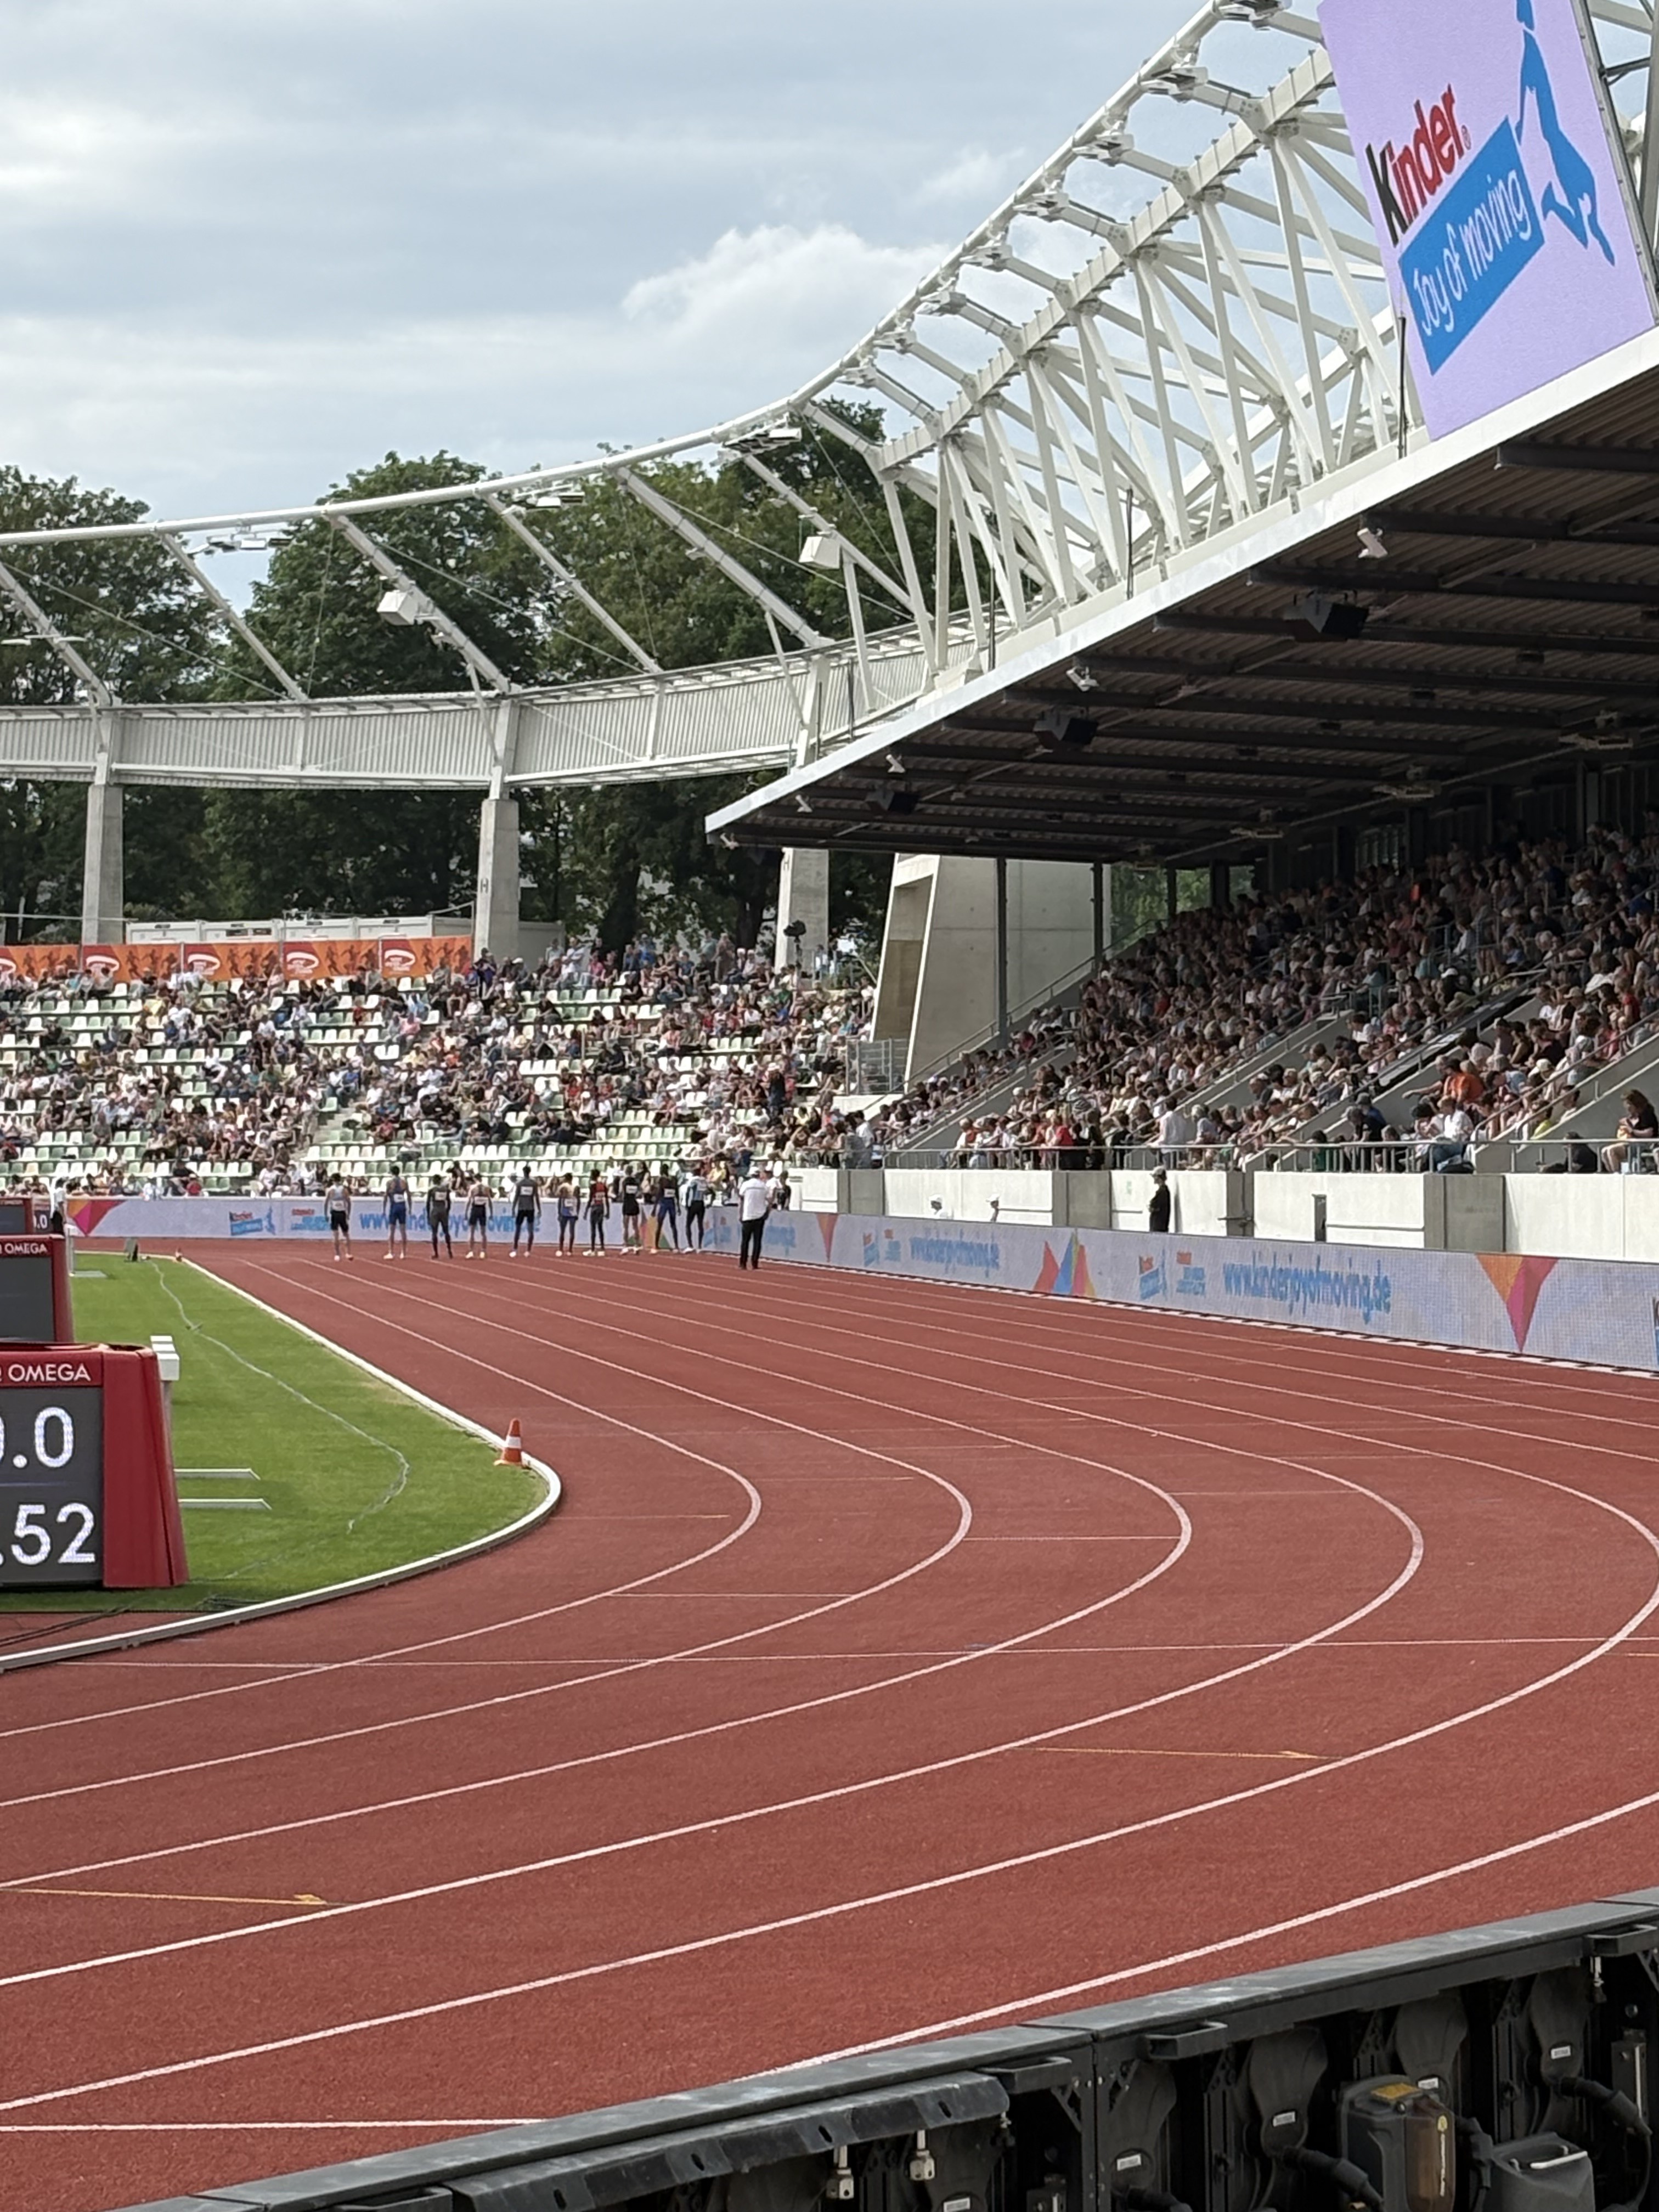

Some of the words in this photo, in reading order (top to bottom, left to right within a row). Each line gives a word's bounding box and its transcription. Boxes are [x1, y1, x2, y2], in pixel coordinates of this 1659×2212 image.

[1413, 268, 1454, 336] Joy
[1443, 223, 1468, 301] of
[1458, 170, 1531, 281] moving
[4, 1243, 48, 1254] OMEGA
[8, 1363, 91, 1382] OMEGA
[0, 1407, 74, 1468] .0
